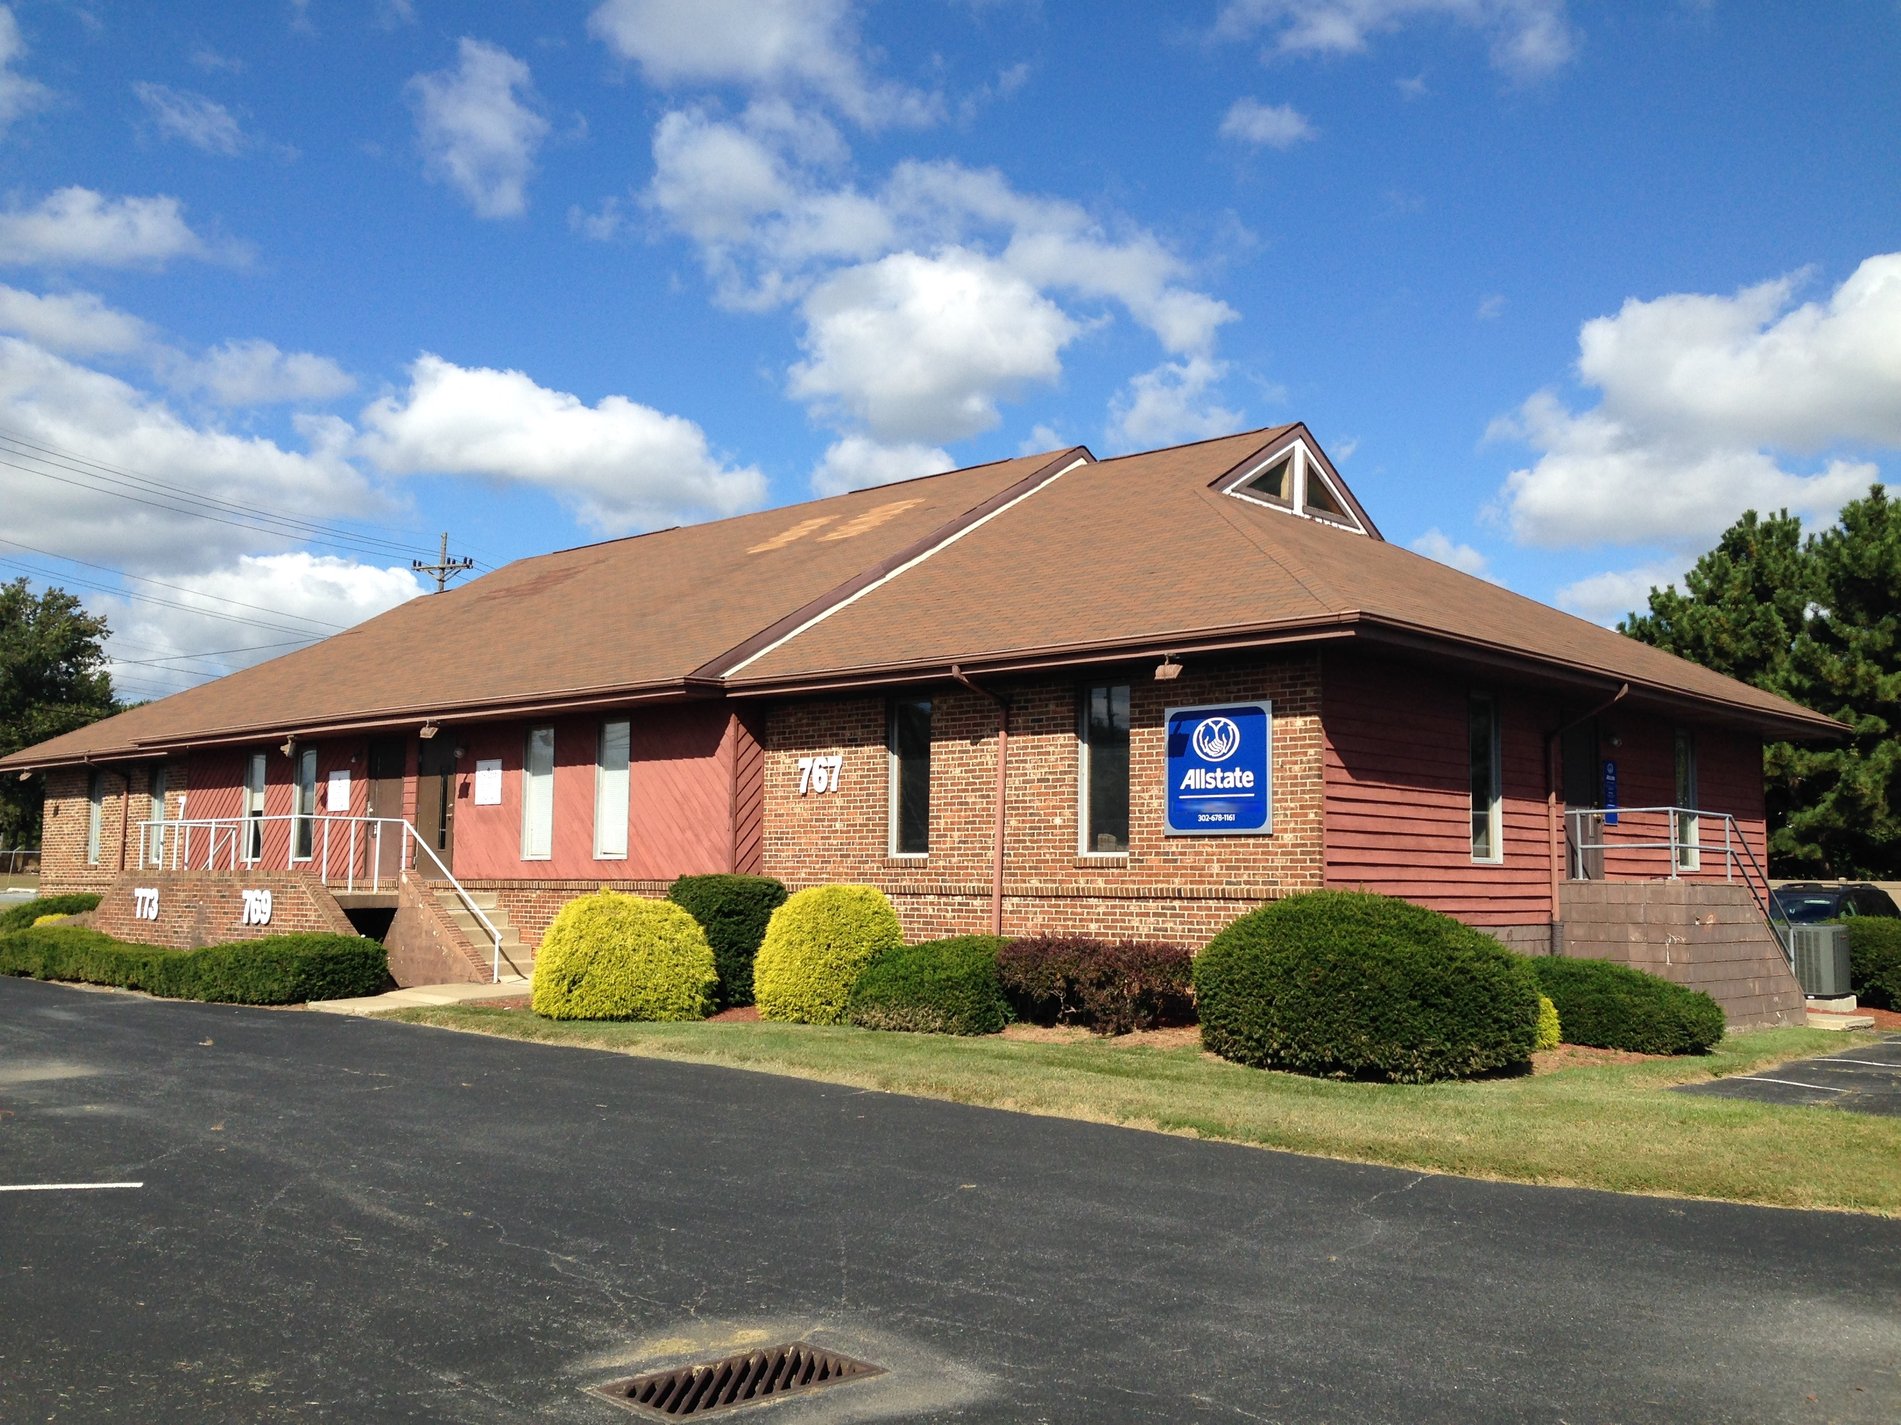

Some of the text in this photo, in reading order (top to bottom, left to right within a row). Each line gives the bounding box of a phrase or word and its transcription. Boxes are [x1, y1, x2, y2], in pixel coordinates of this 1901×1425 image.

[798, 756, 842, 794] 767
[1180, 767, 1254, 790] Allstate
[134, 888, 159, 920] 773
[242, 889, 272, 925] 769
